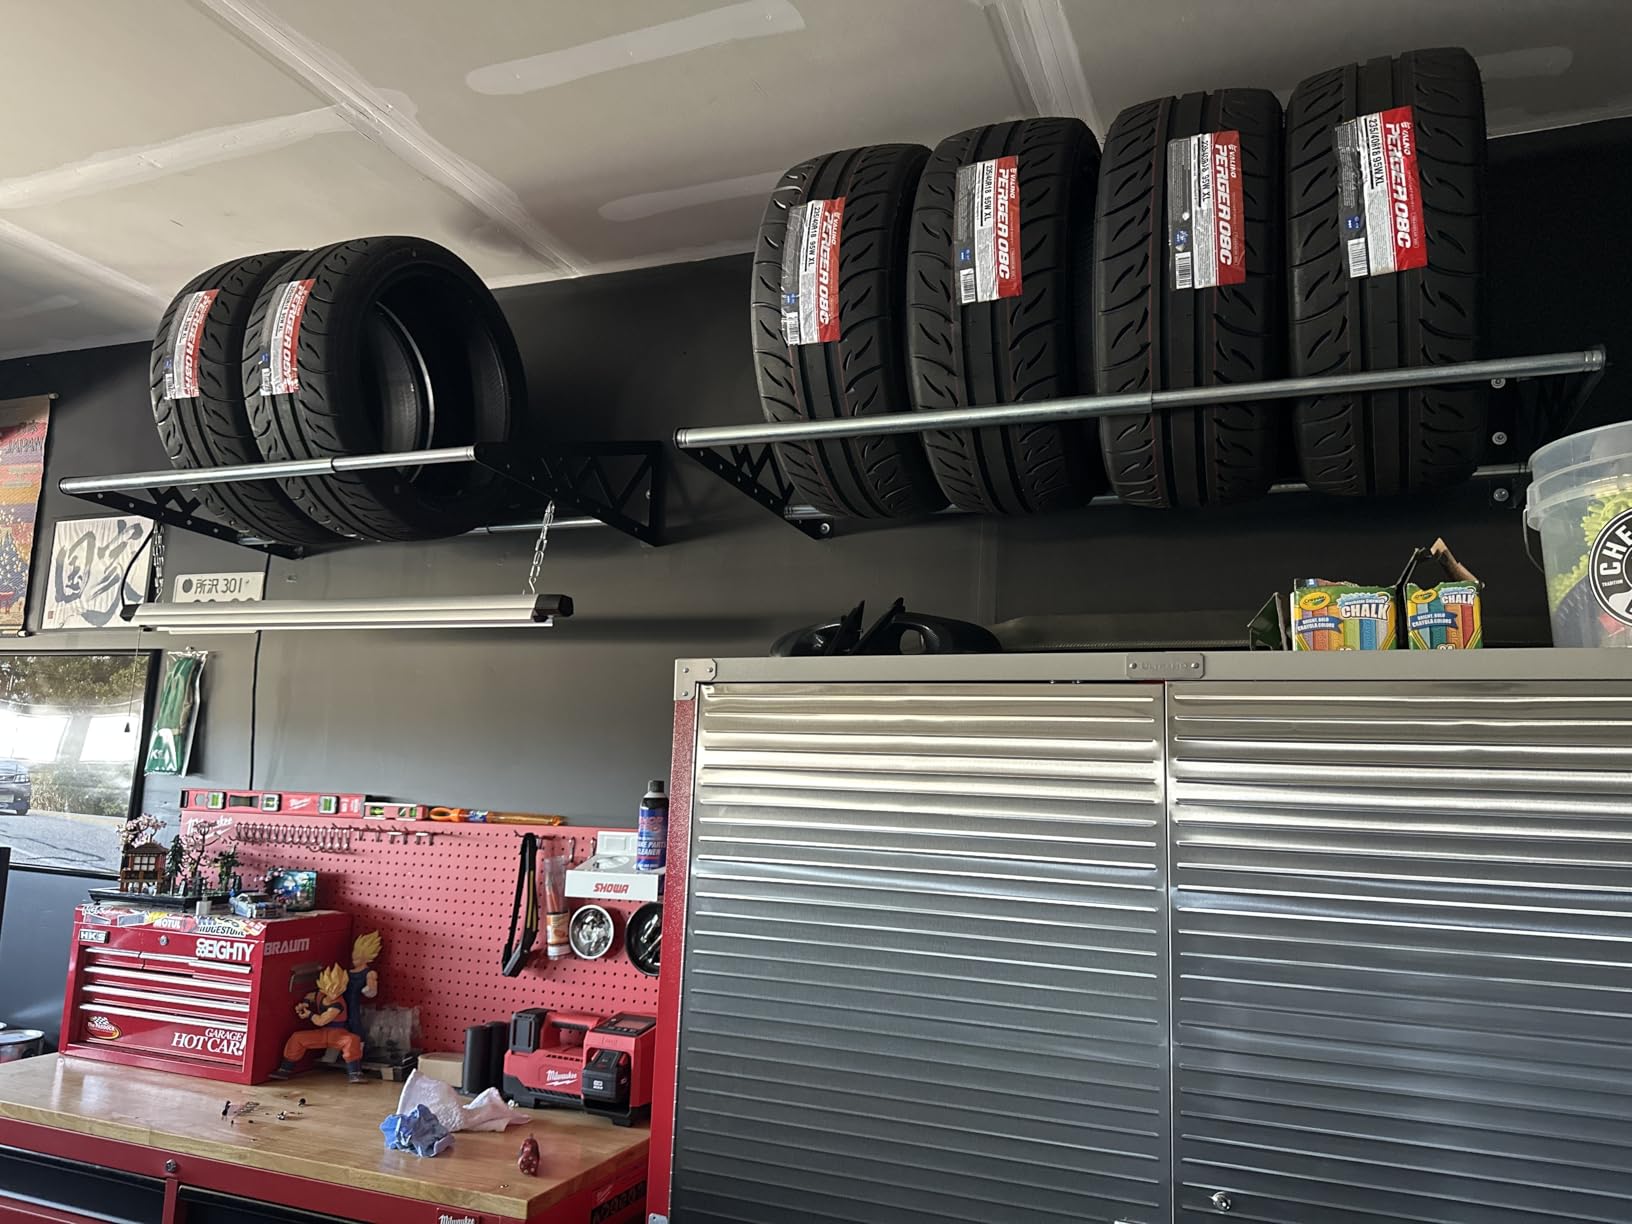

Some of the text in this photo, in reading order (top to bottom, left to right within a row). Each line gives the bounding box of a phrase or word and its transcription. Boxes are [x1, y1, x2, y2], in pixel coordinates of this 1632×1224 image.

[1373, 157, 1384, 175] 95W
[1202, 173, 1210, 190] 95W
[1376, 175, 1385, 186] XL
[1203, 190, 1211, 202] XL
[984, 196, 992, 213] 95W
[983, 213, 991, 222] XL
[808, 240, 817, 258] 95W
[1218, 221, 1232, 266] 08C
[808, 258, 816, 267] XL
[998, 240, 1010, 280] 08C
[221, 577, 243, 594] 301
[1441, 593, 1475, 605] CHALK
[1340, 603, 1390, 620] CHALK
[593, 882, 629, 894] SHOWA
[153, 918, 181, 928] MOTUL
[80, 931, 106, 942] HKS
[264, 938, 310, 956] BRAUM
[171, 1032, 208, 1050] HOT
[205, 1028, 244, 1041] GARAGE
[546, 1069, 577, 1081] Milwaukee
